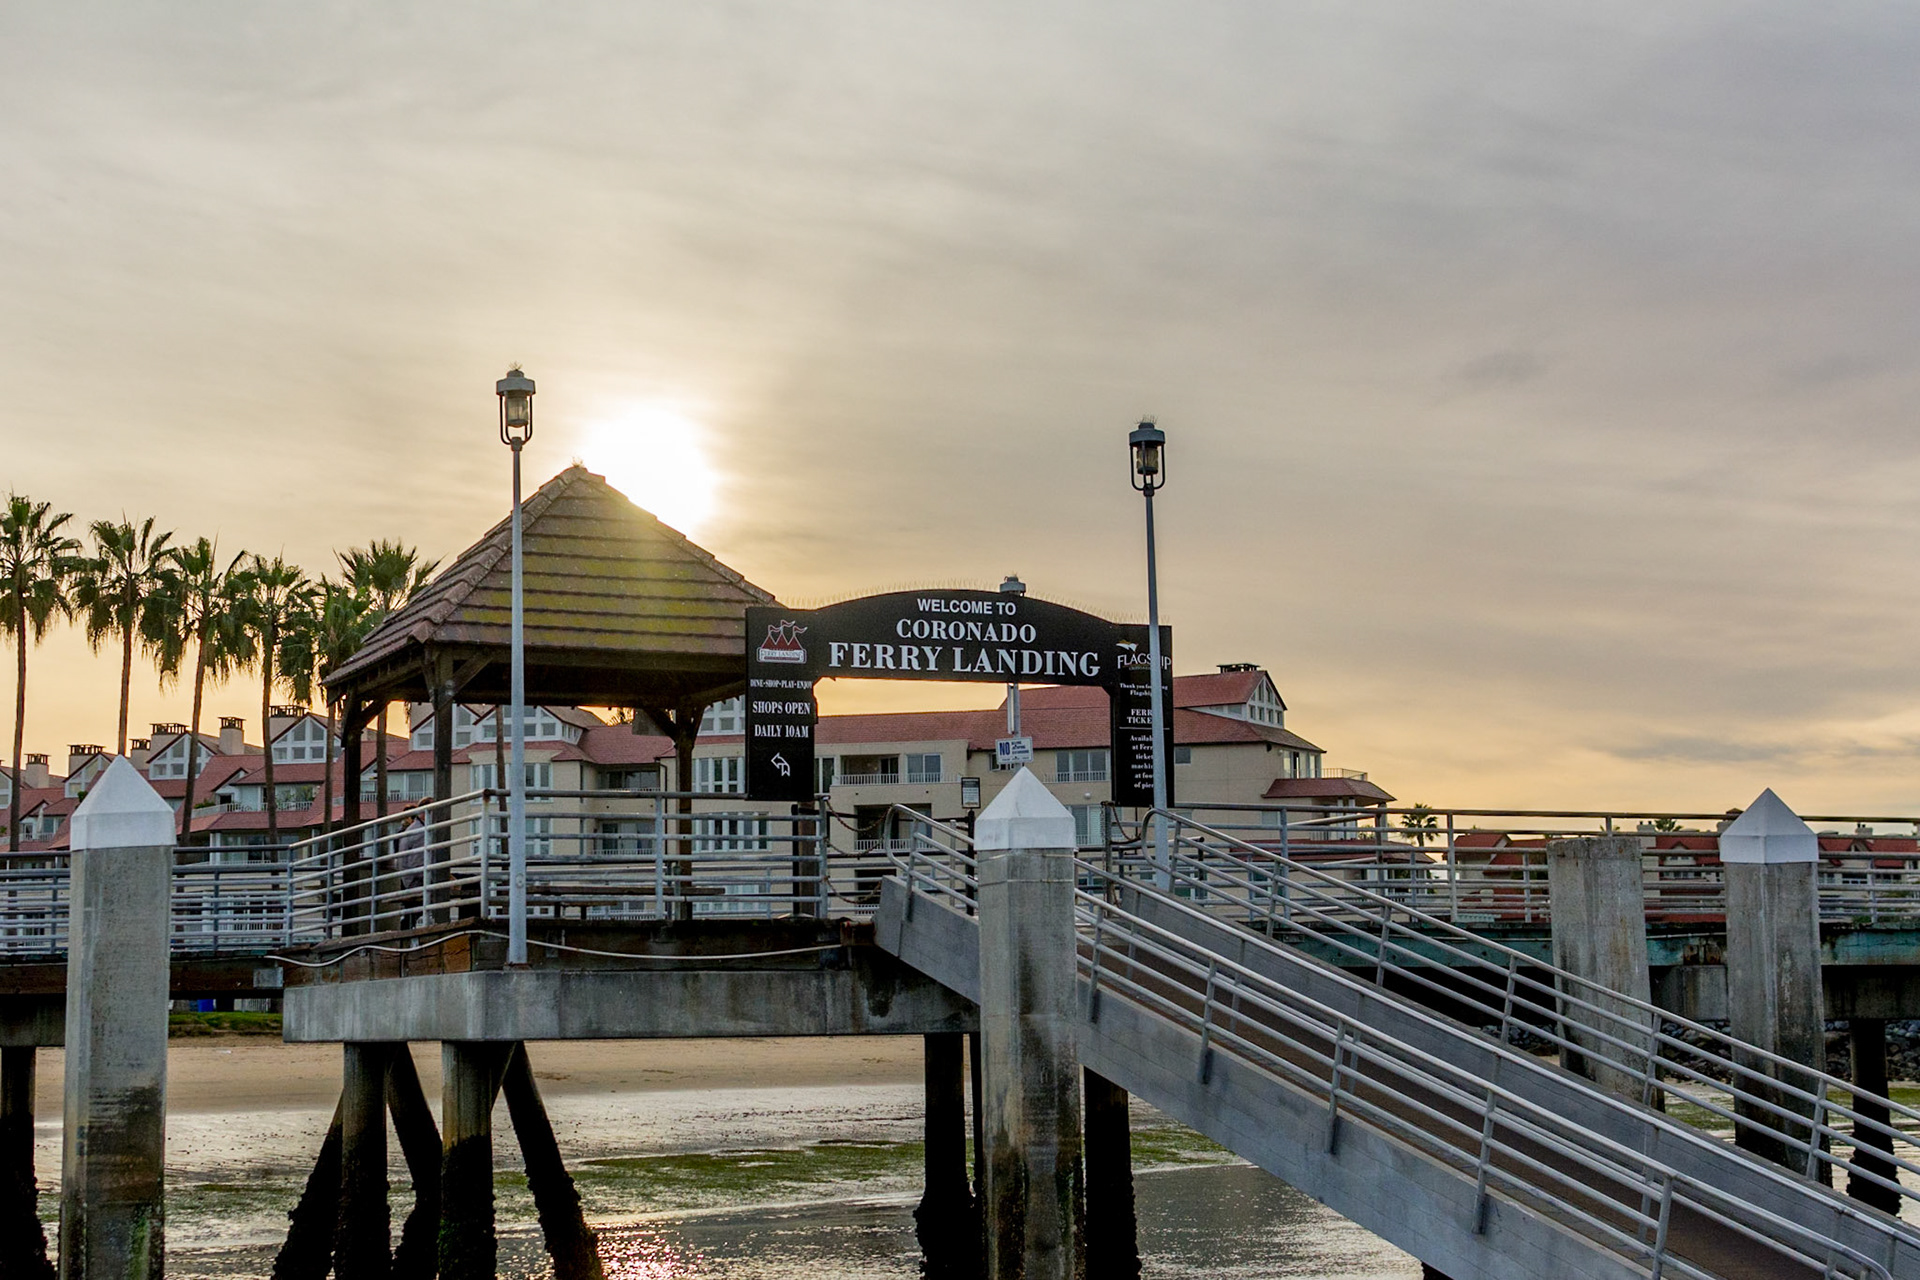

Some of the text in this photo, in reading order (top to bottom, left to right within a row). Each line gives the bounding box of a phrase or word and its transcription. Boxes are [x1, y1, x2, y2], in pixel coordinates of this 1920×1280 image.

[917, 598, 1017, 616] WELCOME TO
[896, 618, 1037, 644] CORONADO
[828, 641, 1101, 677] FERRY LANDING
[1117, 653, 1172, 670] FLAGSIP
[752, 700, 811, 715] SHOPS OPEN
[754, 724, 809, 738] DAILY 10AM
[999, 742, 1010, 755] NO
[1140, 743, 1153, 751] Ferr
[1142, 771, 1153, 779] foo
